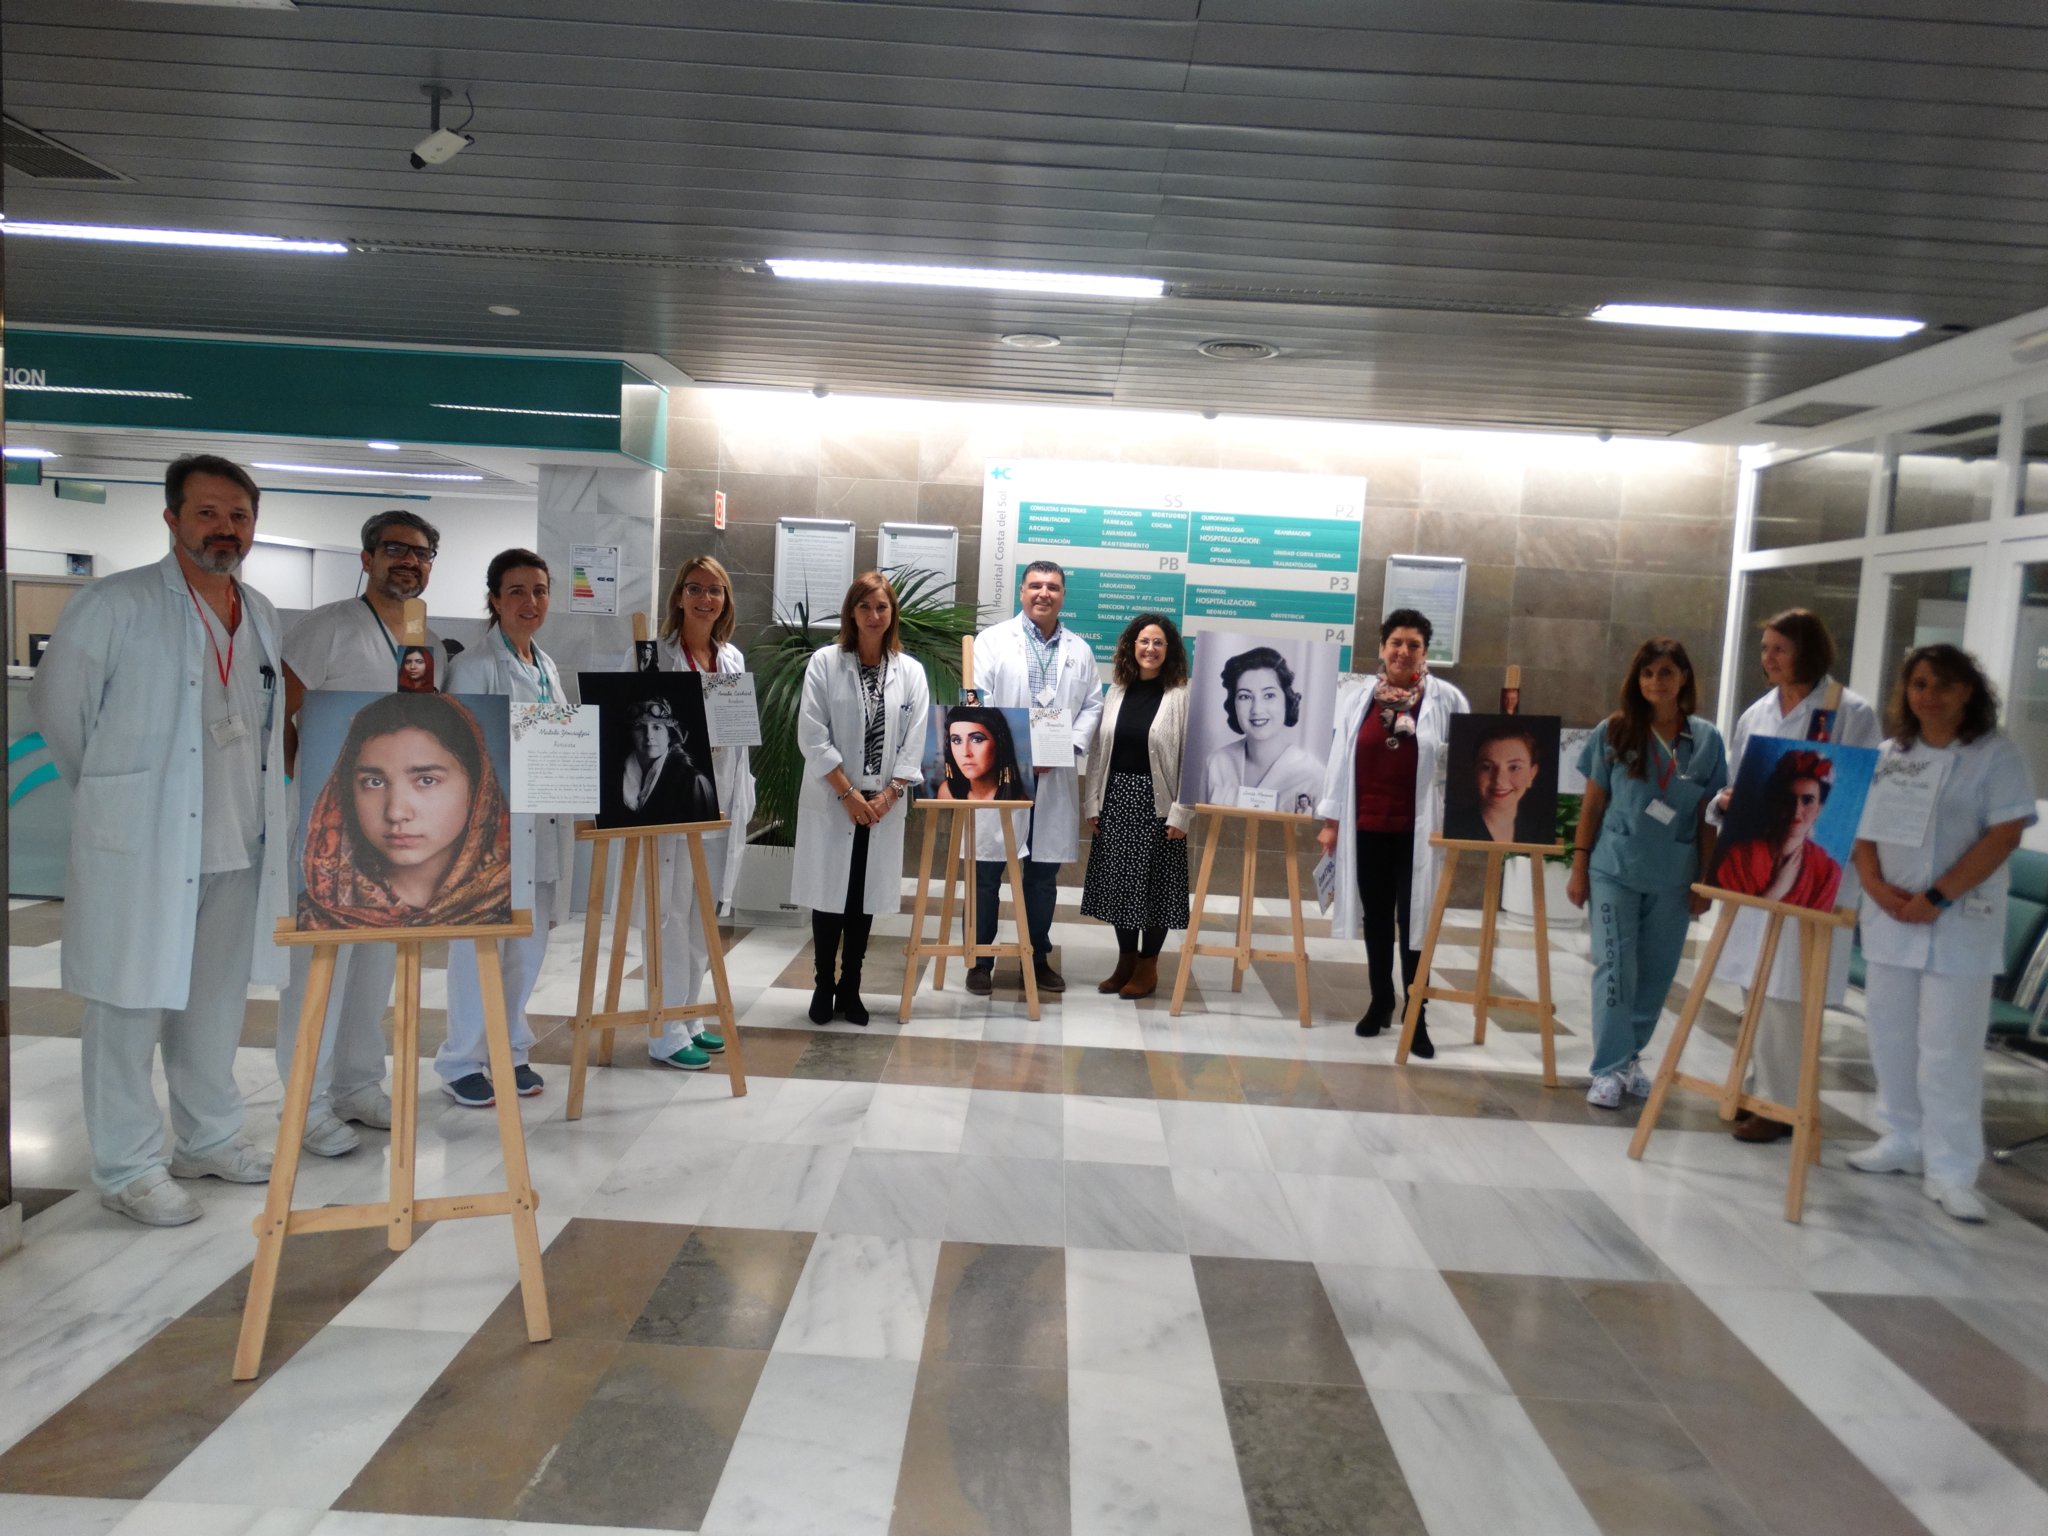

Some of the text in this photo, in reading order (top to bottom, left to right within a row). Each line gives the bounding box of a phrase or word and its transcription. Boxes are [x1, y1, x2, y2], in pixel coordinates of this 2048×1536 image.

[1163, 494, 1183, 508] SS
[1029, 504, 1088, 514] CONSULTAS EXTERNAS
[1103, 509, 1143, 517] EXTRACCIONES
[1335, 504, 1355, 518] P2
[1151, 511, 1188, 519] MORTUORIO
[1103, 518, 1134, 526] FARMACIA
[1151, 522, 1172, 530] COCINA
[1028, 525, 1055, 533] ARCHIVO
[1101, 540, 1150, 549] MANTENIMIENTO
[1200, 534, 1261, 545] HOSPITALIZACION:
[992, 490, 1007, 608] Hospital Costa del Sol
[1159, 556, 1180, 571] PB
[1099, 582, 1136, 590] LABORATORIO
[1329, 576, 1350, 591] P3
[1195, 597, 1257, 608] HOSPITALIZACION:
[1097, 603, 1125, 611] DIRECCION
[1131, 605, 1177, 613] ADMINISTRACION
[1206, 608, 1237, 616] NEONATOS
[1097, 613, 1115, 621] SALON
[1324, 628, 1346, 643] P4
[1600, 903, 1616, 1008] QUIROFANO
